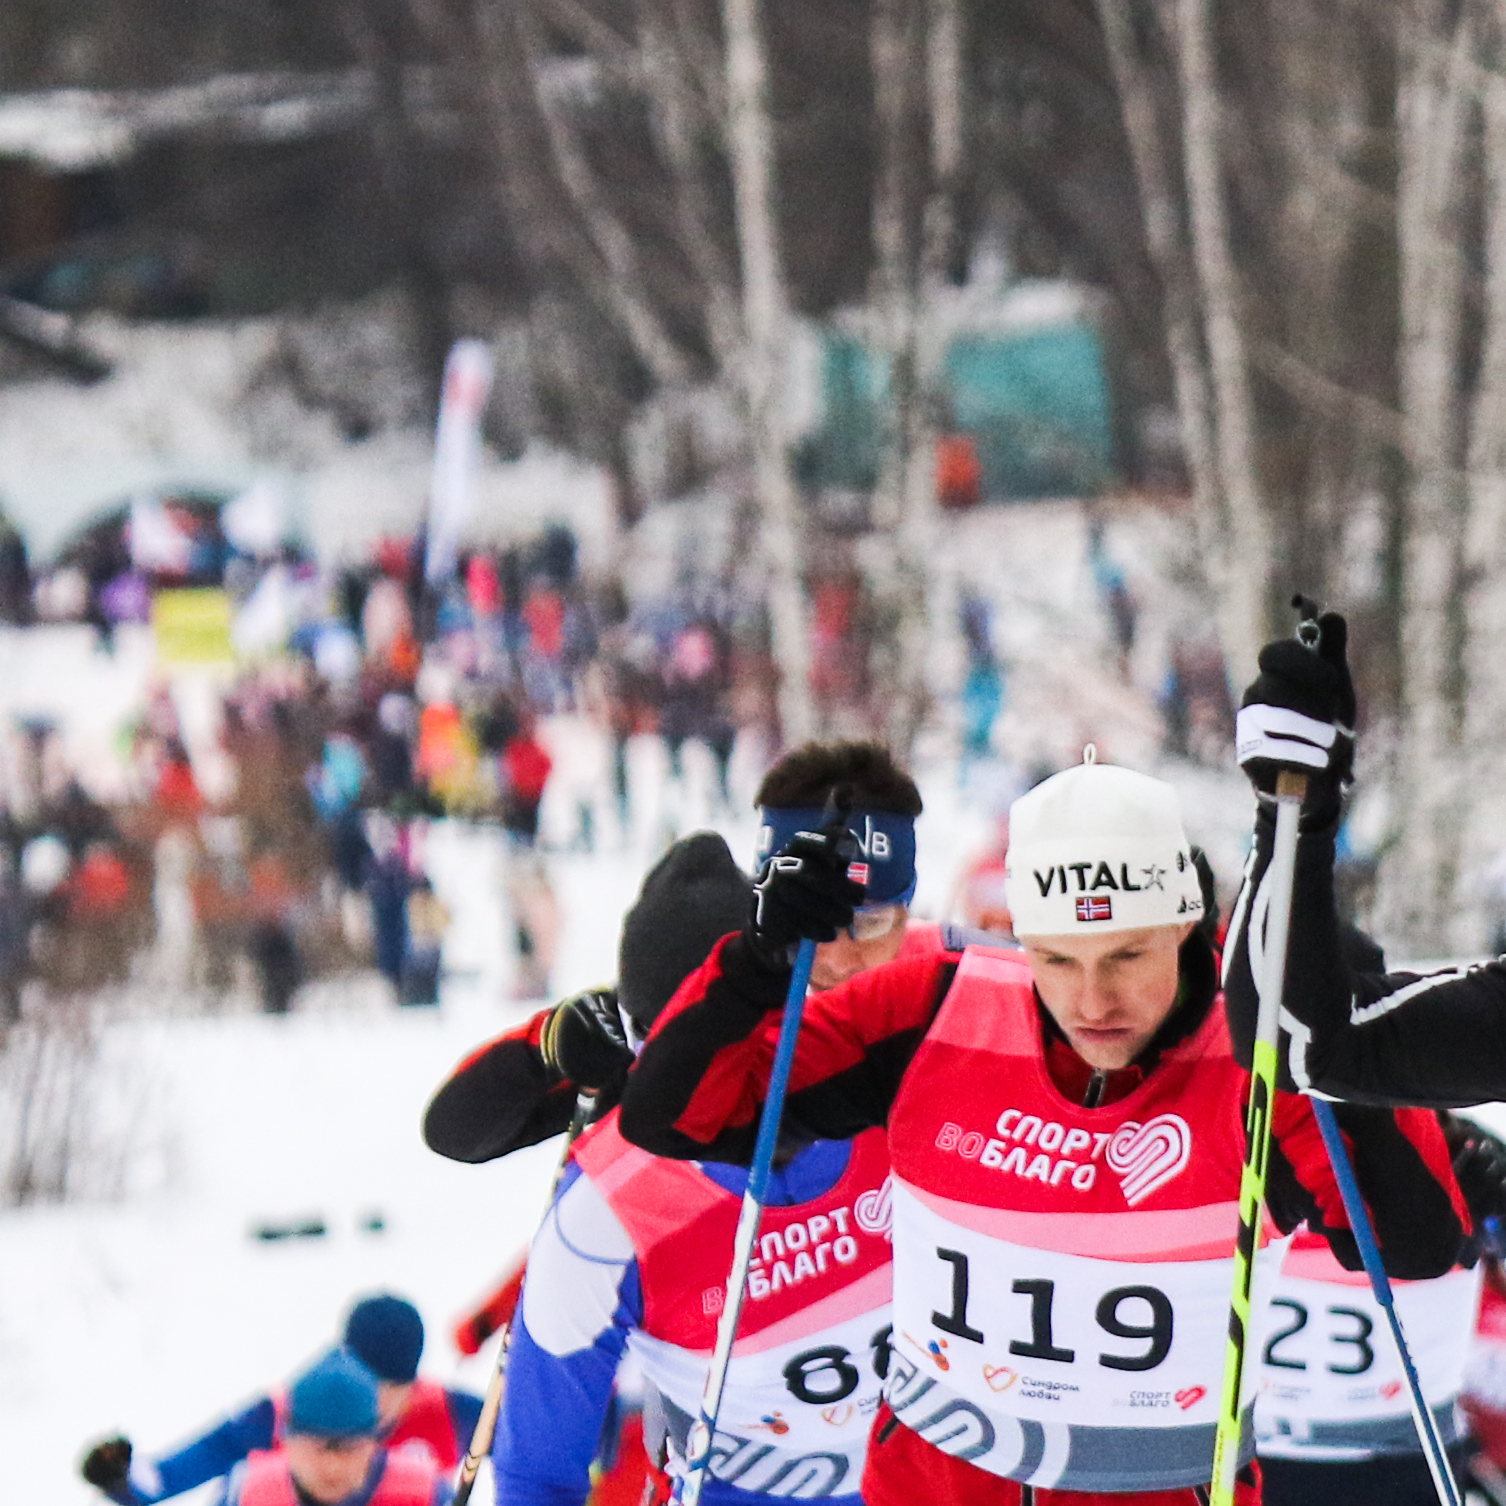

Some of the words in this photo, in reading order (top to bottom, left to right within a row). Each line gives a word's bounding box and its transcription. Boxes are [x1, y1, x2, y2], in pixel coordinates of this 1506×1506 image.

[1033, 861, 1143, 898] VITAL
[995, 1108, 1114, 1159] СПОРТ
[750, 1206, 850, 1267] ПОРТ
[702, 1235, 858, 1315] ВБЛАГО
[930, 1245, 1174, 1373] 119
[1022, 1375, 1080, 1394] Синдром
